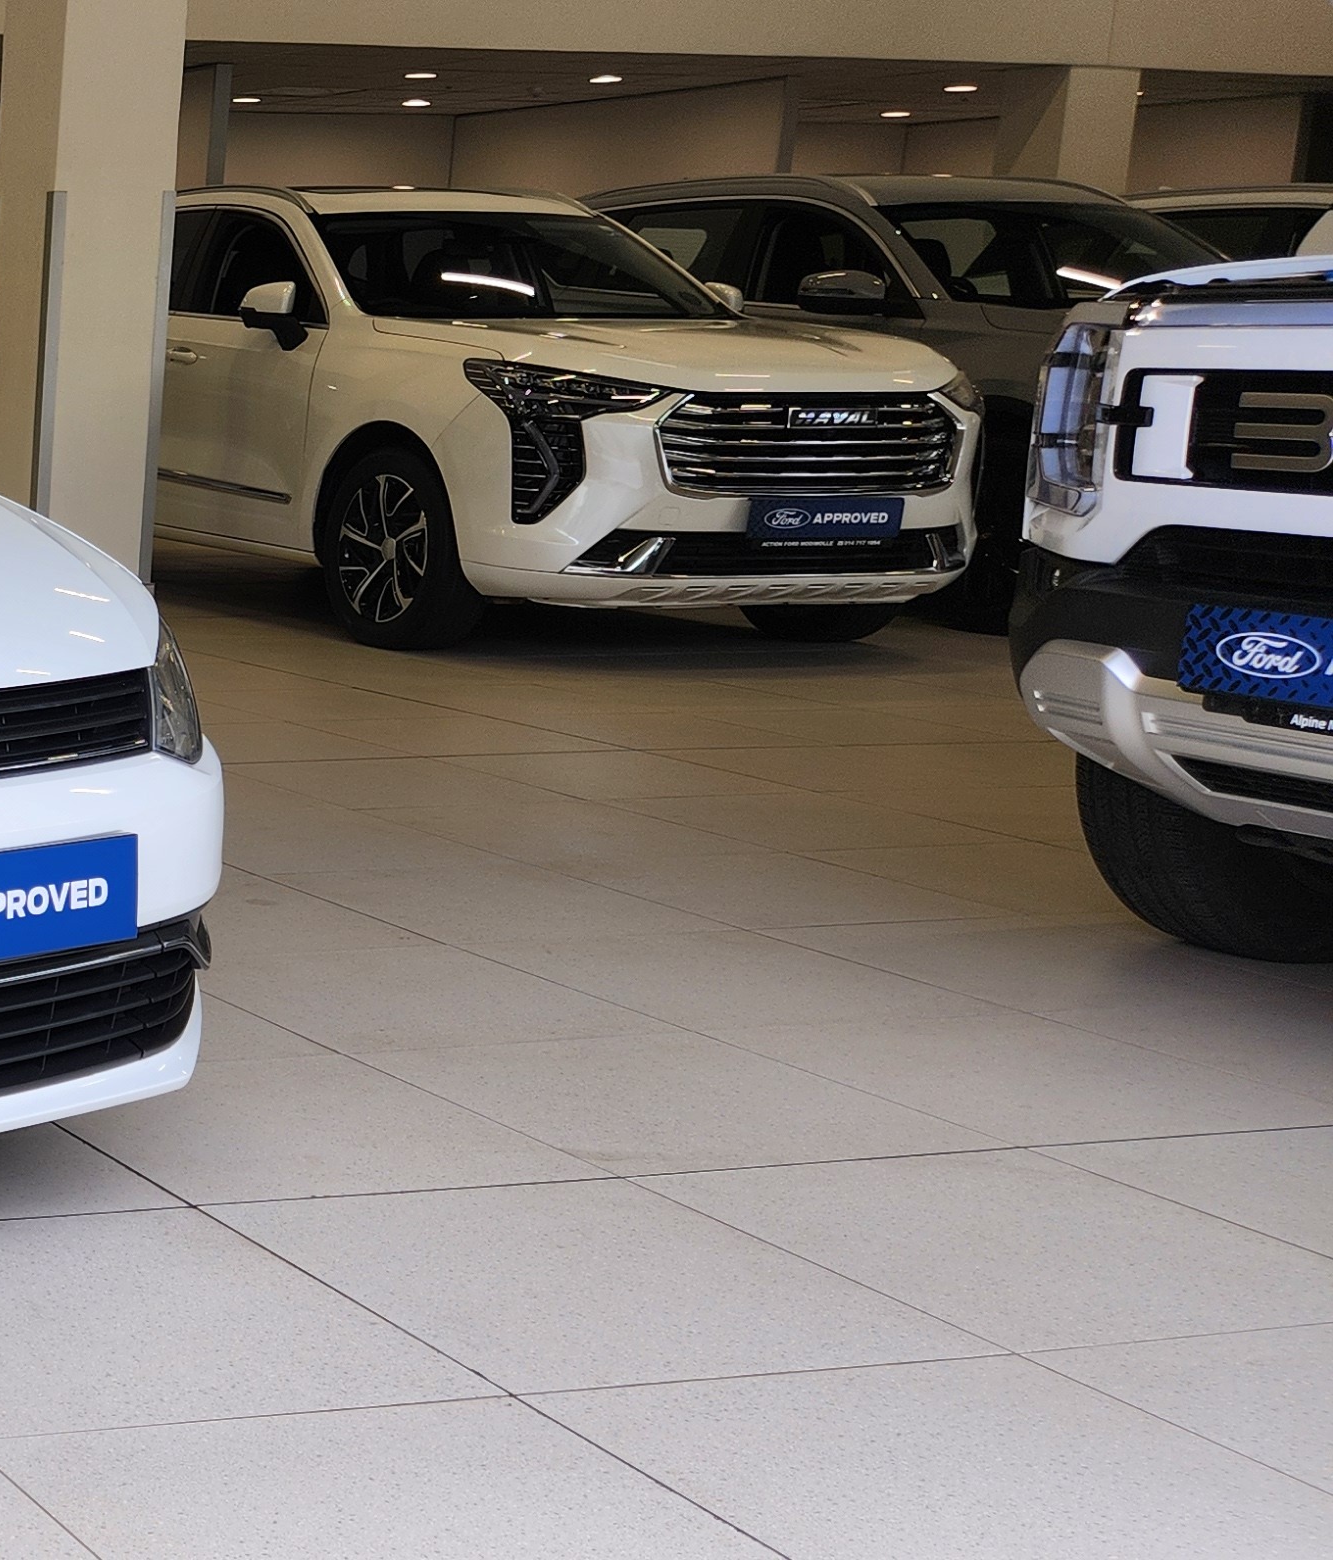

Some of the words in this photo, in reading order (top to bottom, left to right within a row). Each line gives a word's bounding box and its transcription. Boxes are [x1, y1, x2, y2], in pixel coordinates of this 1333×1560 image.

[795, 411, 874, 425] HAVAL
[812, 512, 889, 524] APPROVED
[1289, 713, 1328, 730] Alpine
